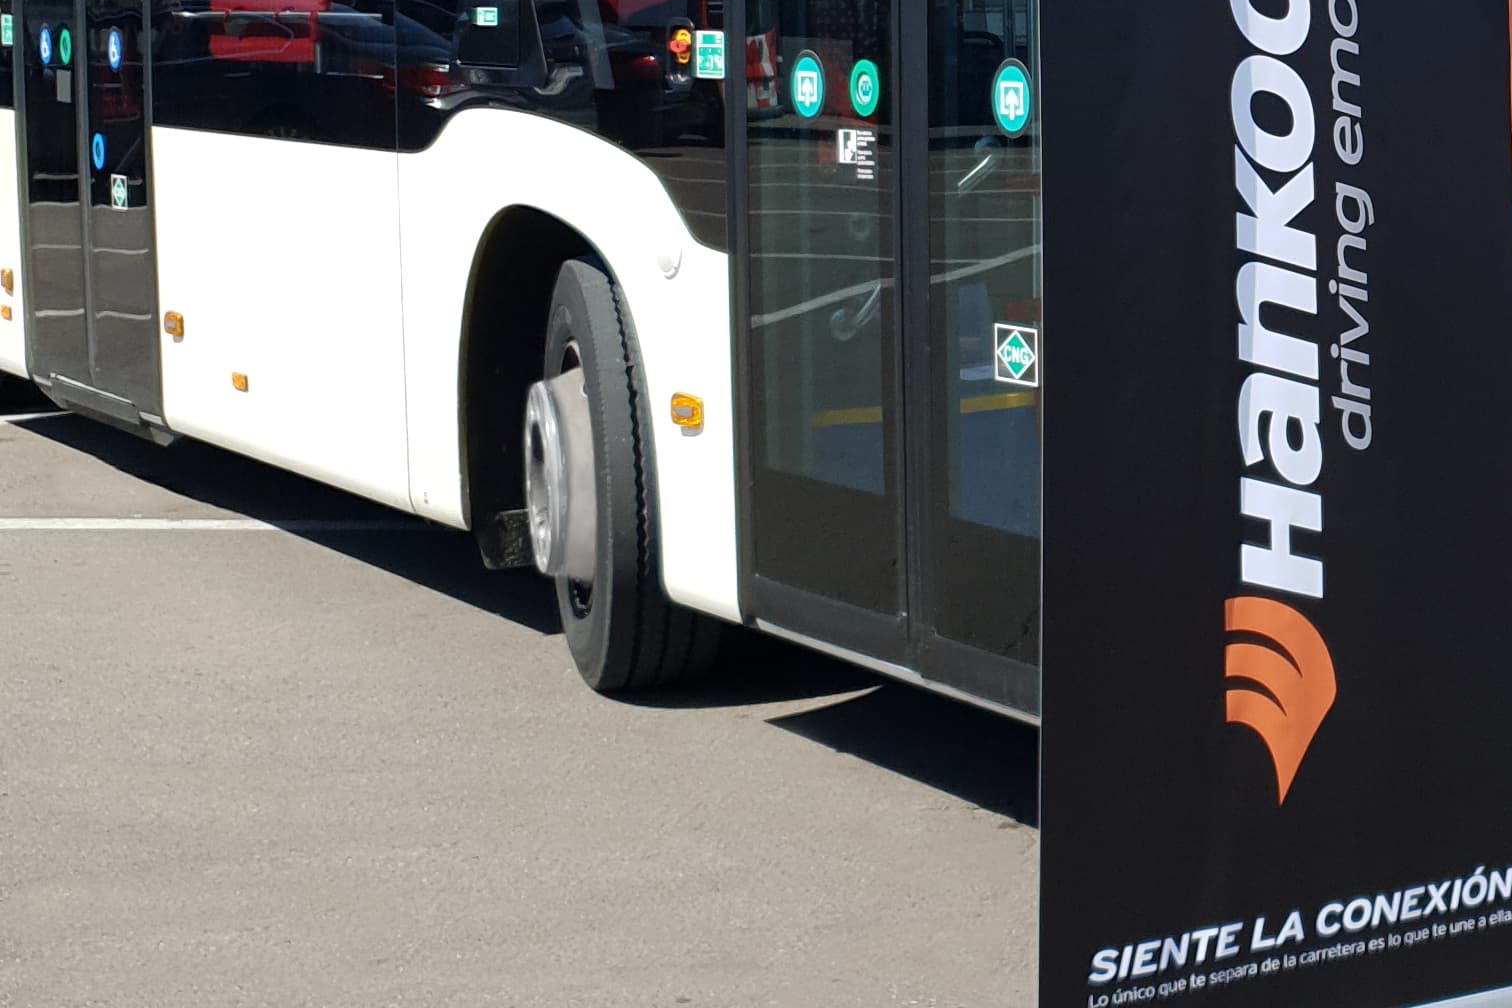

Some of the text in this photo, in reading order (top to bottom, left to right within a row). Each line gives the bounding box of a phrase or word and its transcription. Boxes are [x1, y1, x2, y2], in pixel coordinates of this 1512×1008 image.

[1003, 345, 1029, 365] CNG
[1328, 181, 1375, 451] driving
[1088, 922, 1244, 985] SIENTE
[1250, 910, 1305, 952] LA
[1088, 993, 1109, 1008] Lo
[1112, 985, 1156, 1006] único
[1158, 979, 1187, 998] que
[1189, 973, 1206, 989] te
[1209, 962, 1258, 985] separa
[1260, 957, 1281, 973] de
[1283, 953, 1297, 969] la
[1300, 940, 1366, 966] carretera
[1367, 936, 1386, 952] es
[1388, 932, 1402, 948] lo
[1403, 928, 1430, 946] que
[1432, 922, 1447, 938] te
[1449, 916, 1476, 935] une
[1477, 916, 1487, 929] a
